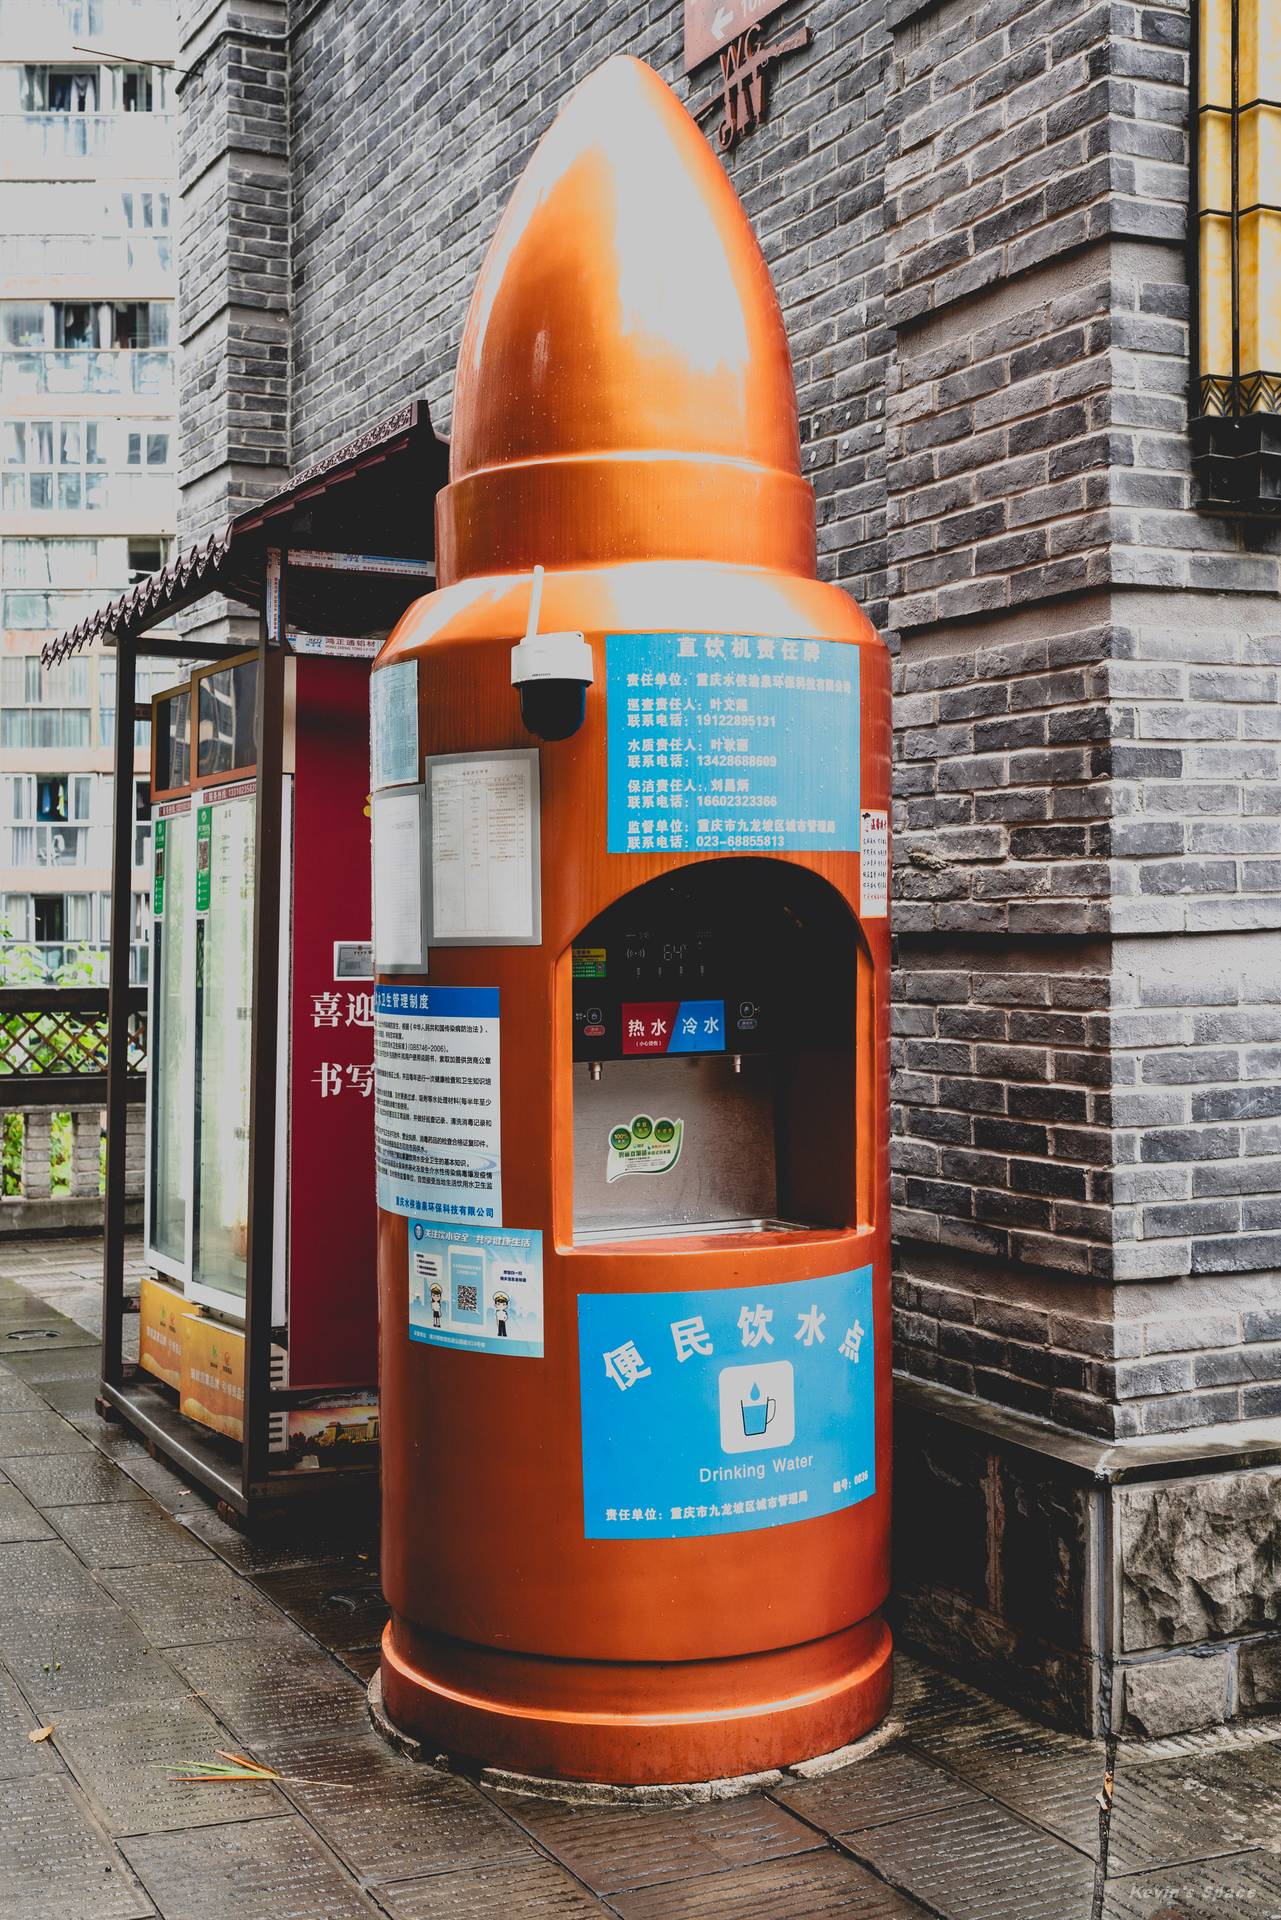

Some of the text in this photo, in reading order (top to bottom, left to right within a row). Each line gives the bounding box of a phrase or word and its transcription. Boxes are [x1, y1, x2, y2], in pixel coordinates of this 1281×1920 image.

[719, 23, 763, 82] WC
[628, 1018, 667, 1037] 热水
[682, 1017, 719, 1035] 冷水
[602, 1304, 865, 1391] 便民饮水点
[699, 1455, 814, 1483] Drinking Water
